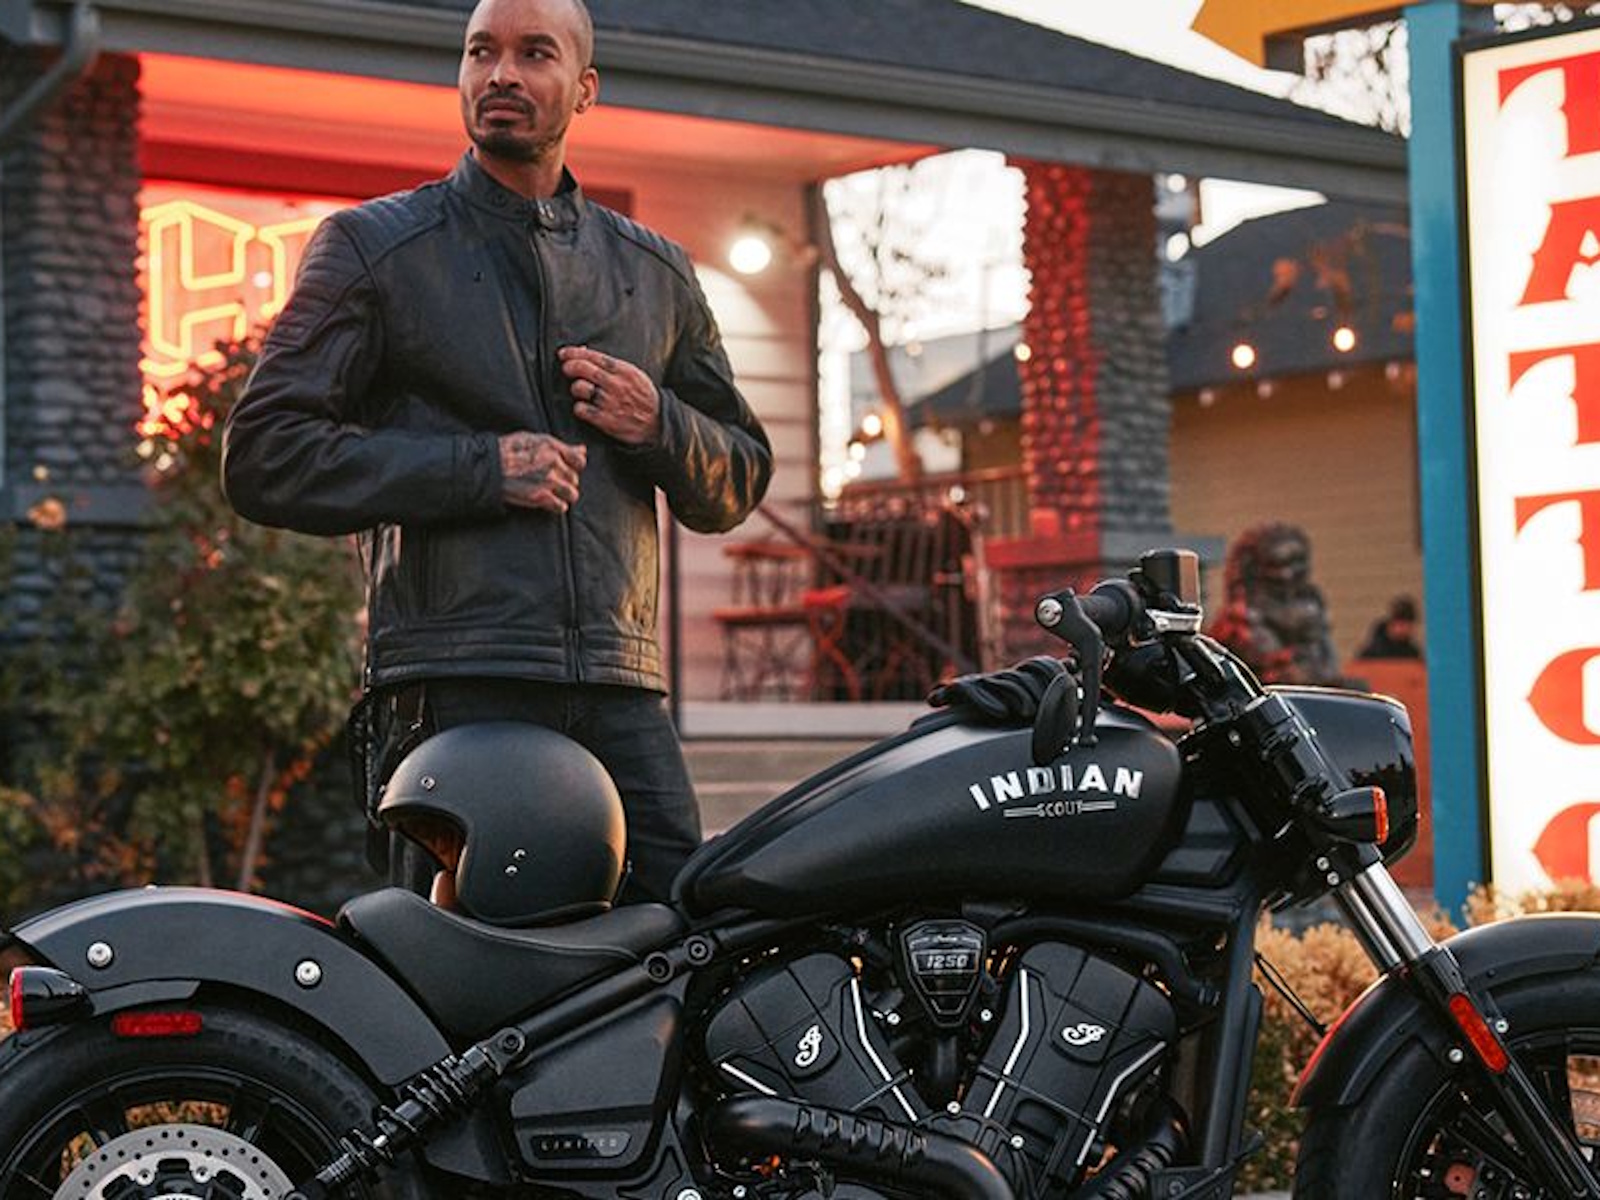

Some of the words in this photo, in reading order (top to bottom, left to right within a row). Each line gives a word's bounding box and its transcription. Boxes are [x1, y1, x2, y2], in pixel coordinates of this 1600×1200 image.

[968, 763, 1144, 811] INDIAN
[1037, 801, 1084, 818] SCOUT
[926, 955, 969, 969] 1250
